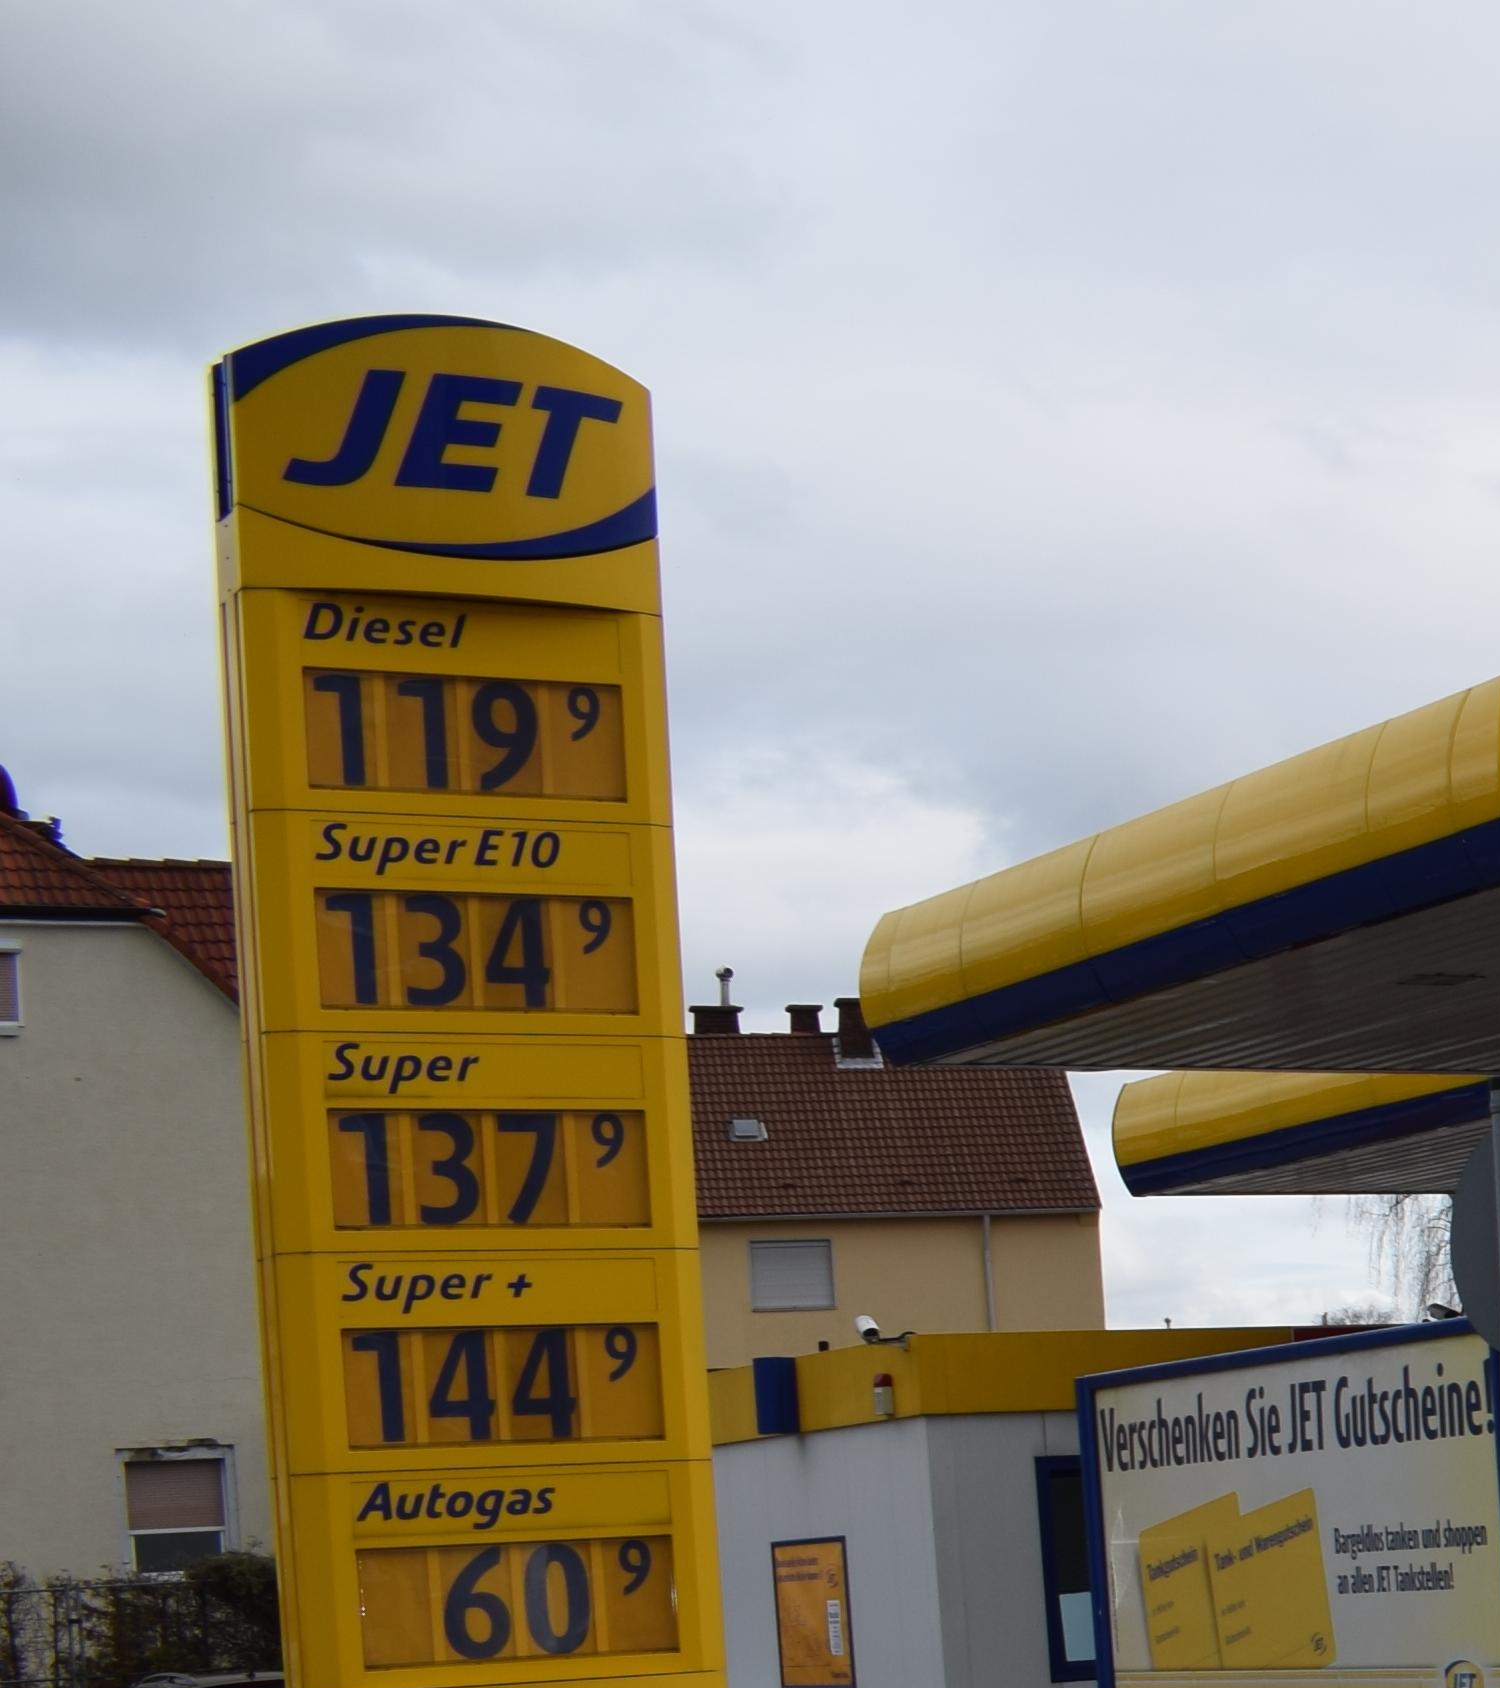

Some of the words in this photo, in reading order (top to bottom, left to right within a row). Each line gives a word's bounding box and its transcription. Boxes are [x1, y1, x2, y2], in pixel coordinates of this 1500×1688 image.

[282, 369, 623, 500] JET
[303, 602, 467, 649] Diesel
[312, 674, 539, 791] 119
[315, 823, 468, 875] Super
[477, 829, 561, 869] E10
[325, 893, 551, 1009] 134
[327, 1042, 479, 1094] Super
[338, 1112, 559, 1226] 137
[342, 1263, 493, 1313] Super
[352, 1328, 578, 1443] 144
[1100, 1393, 1240, 1472] Verschenken
[1246, 1385, 1281, 1459] Sie
[1287, 1379, 1326, 1454] JET
[1334, 1357, 1494, 1450] Gutscheine!
[356, 1482, 556, 1530] Autogas
[1334, 1524, 1384, 1560] Bargeldlos
[1385, 1522, 1419, 1552] tanken
[1421, 1519, 1441, 1550] und
[1443, 1518, 1488, 1554] shoppen
[443, 1542, 591, 1661] 60
[1337, 1574, 1350, 1595] an
[1350, 1565, 1375, 1594] allen
[1376, 1565, 1392, 1593] JET
[1393, 1562, 1455, 1593] Tankstellen!
